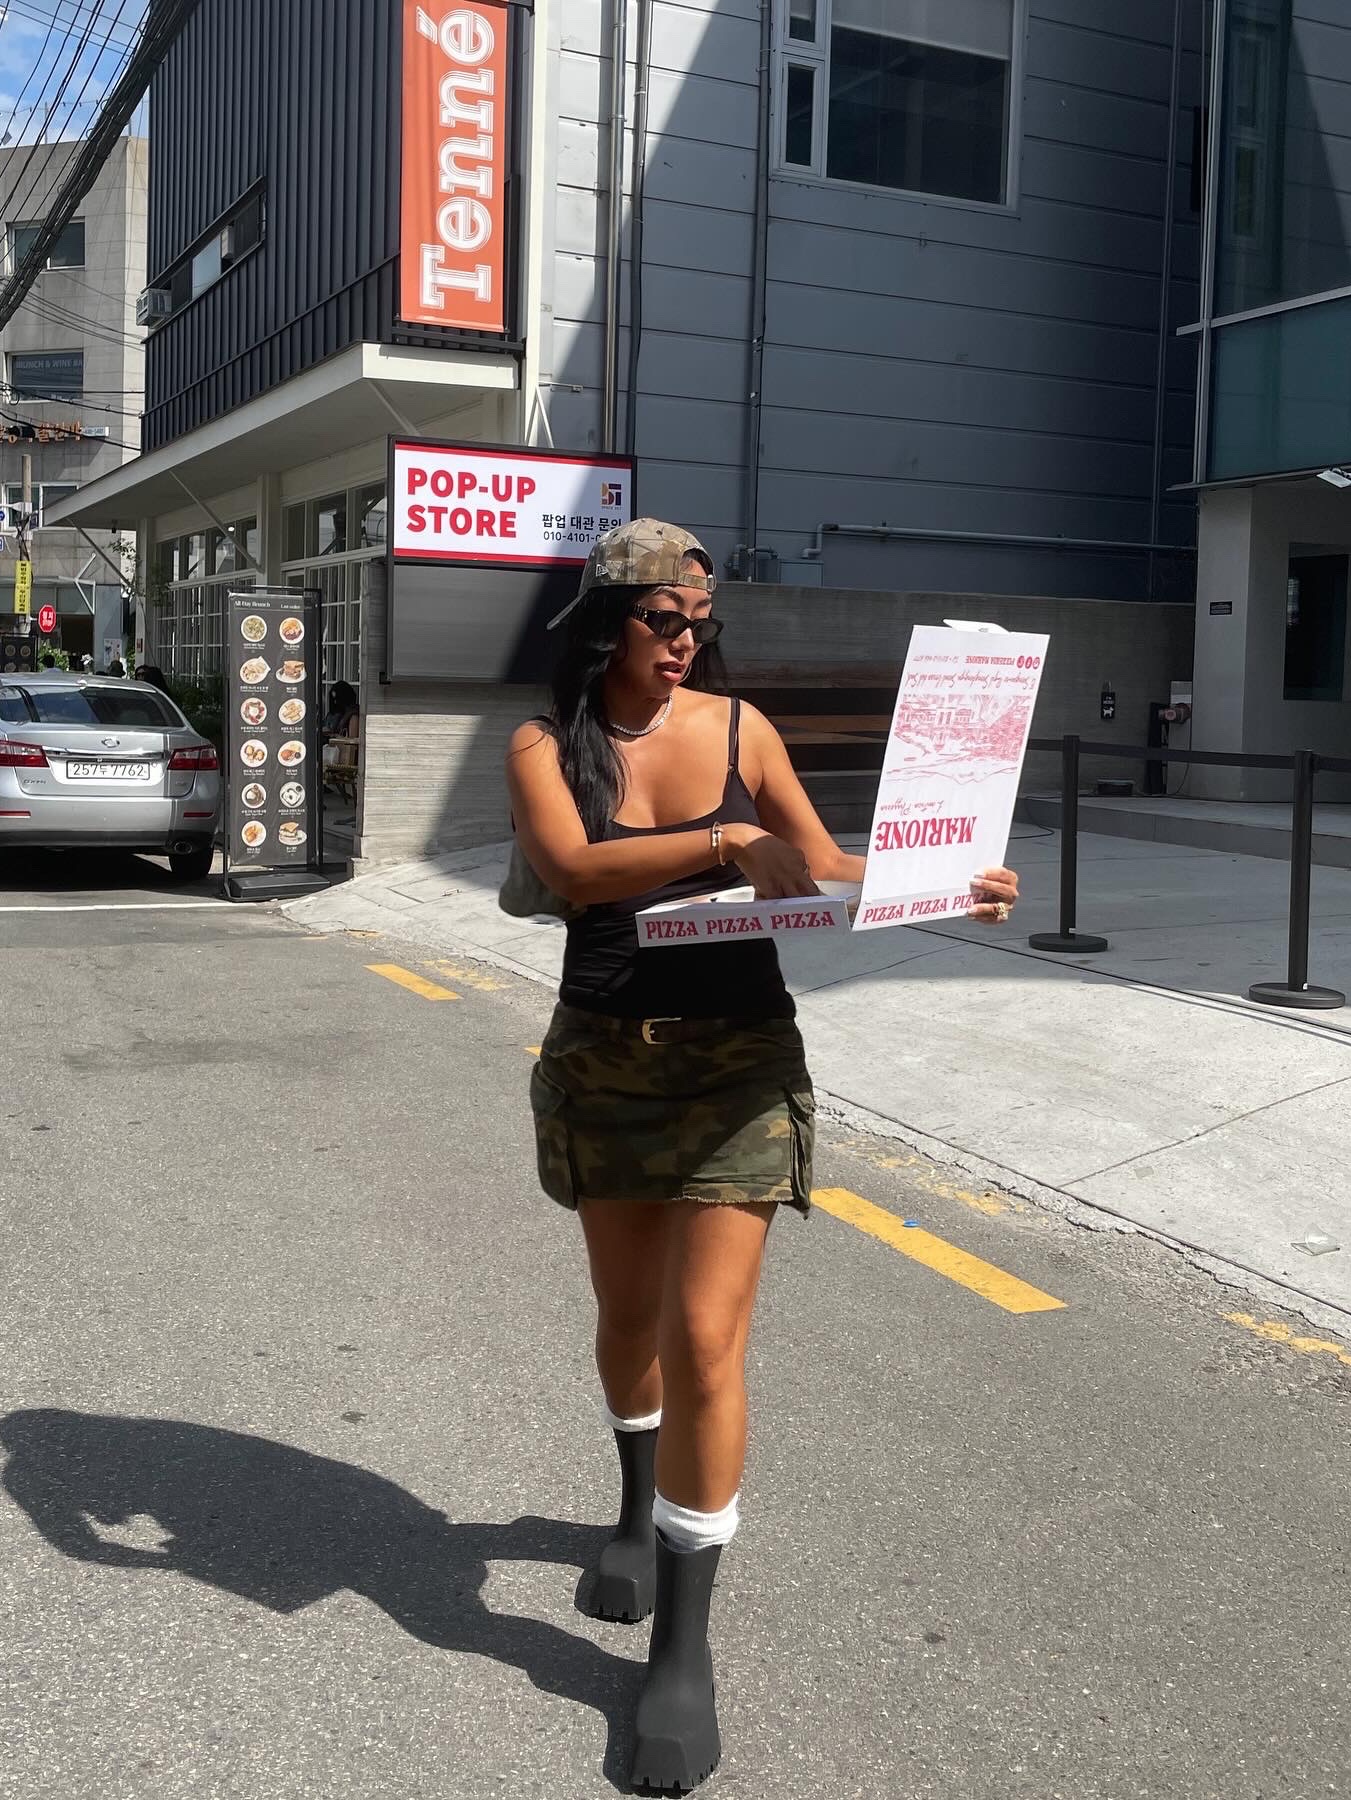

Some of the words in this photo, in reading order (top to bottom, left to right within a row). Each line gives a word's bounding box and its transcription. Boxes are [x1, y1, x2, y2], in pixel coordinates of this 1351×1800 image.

[416, 6, 494, 310] Tenné
[407, 467, 536, 503] POP-UP
[407, 504, 517, 538] STORE
[542, 514, 566, 529] 팝업
[570, 516, 594, 531] 대관
[598, 517, 622, 532] 문의
[110, 763, 145, 776] 7762
[875, 816, 977, 852] MARIONE
[862, 904, 905, 923] PIZZA
[909, 898, 948, 916] PIZZA
[952, 892, 981, 910] PIZZ
[645, 920, 699, 939] PIZZA
[705, 916, 763, 935] PIZZA
[770, 911, 835, 929] PIZZA
